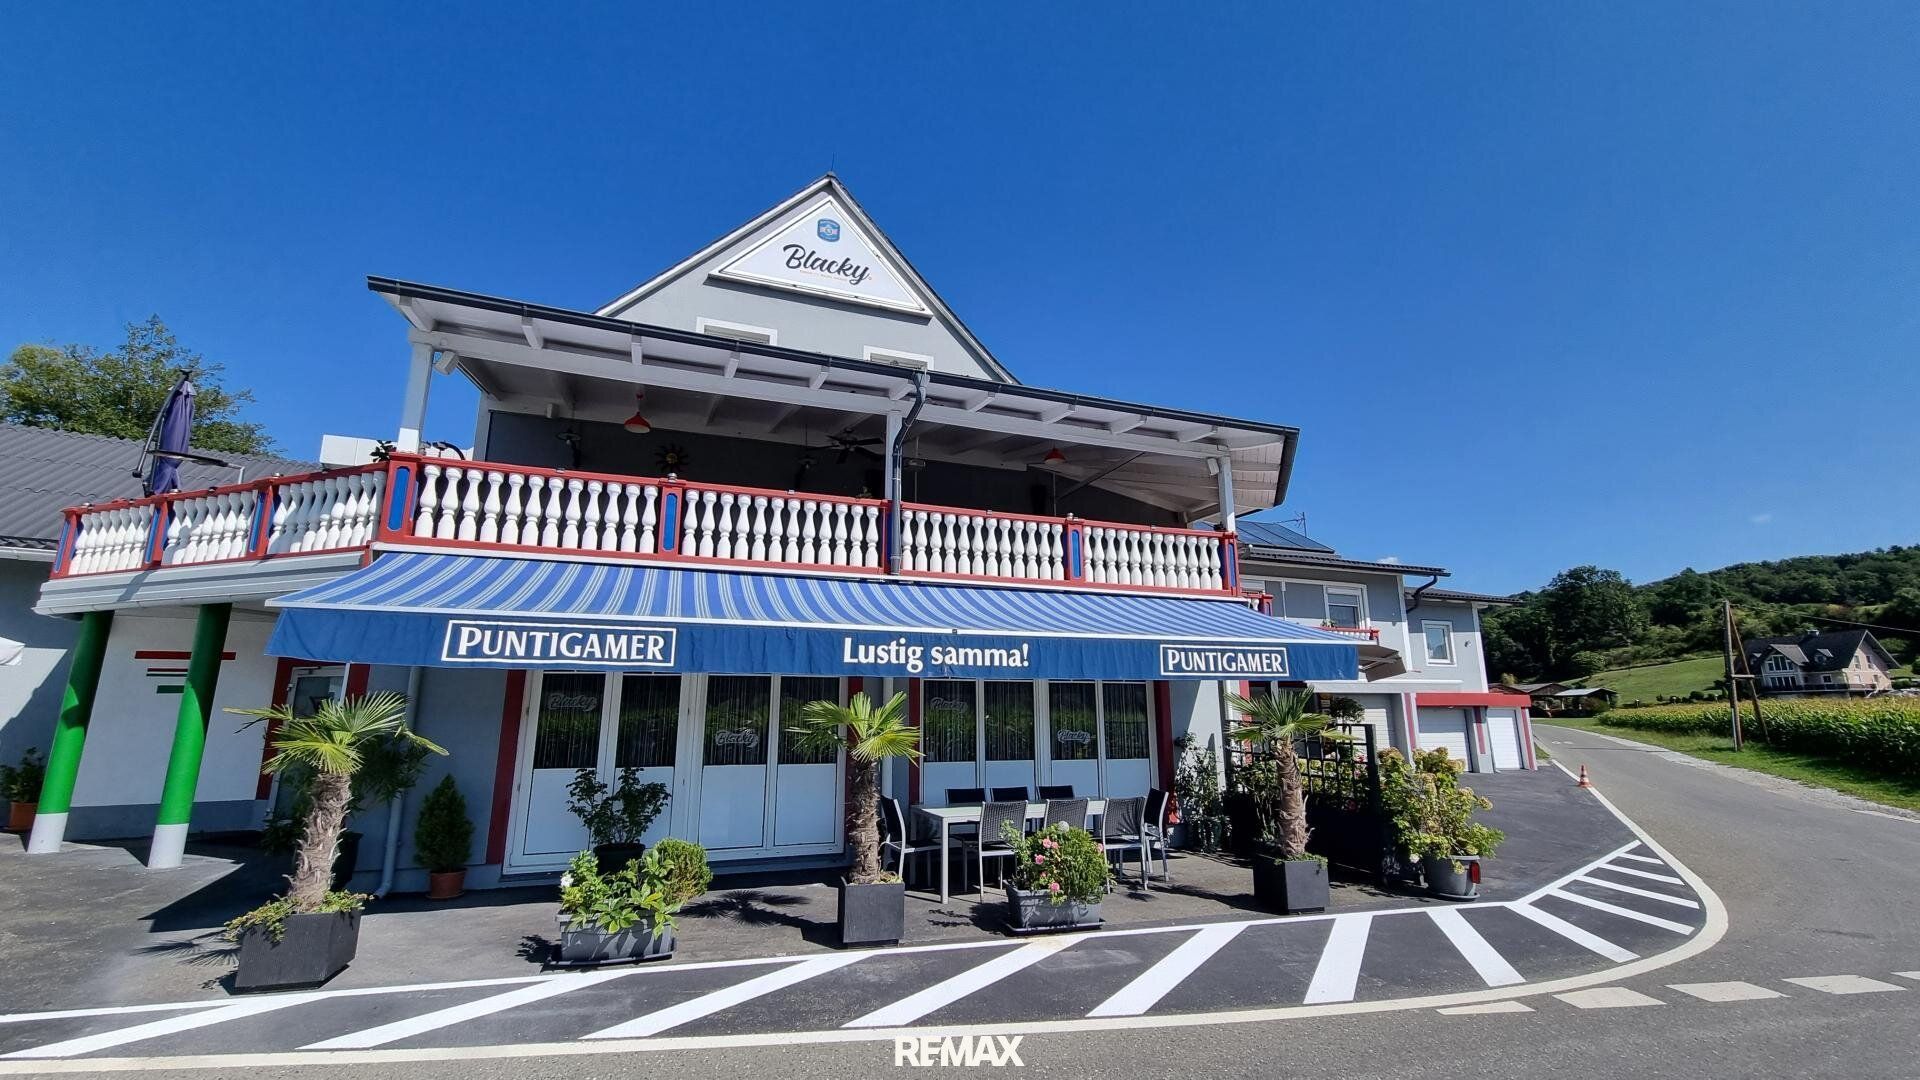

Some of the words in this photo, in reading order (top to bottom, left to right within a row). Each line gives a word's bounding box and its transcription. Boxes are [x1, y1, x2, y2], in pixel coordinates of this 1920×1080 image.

[783, 244, 869, 285] Blacky
[457, 627, 665, 660] PUNTIGAMER
[843, 637, 924, 673] Lustig
[931, 643, 1029, 667] samma!
[1167, 649, 1284, 672] PUNTIGAMER
